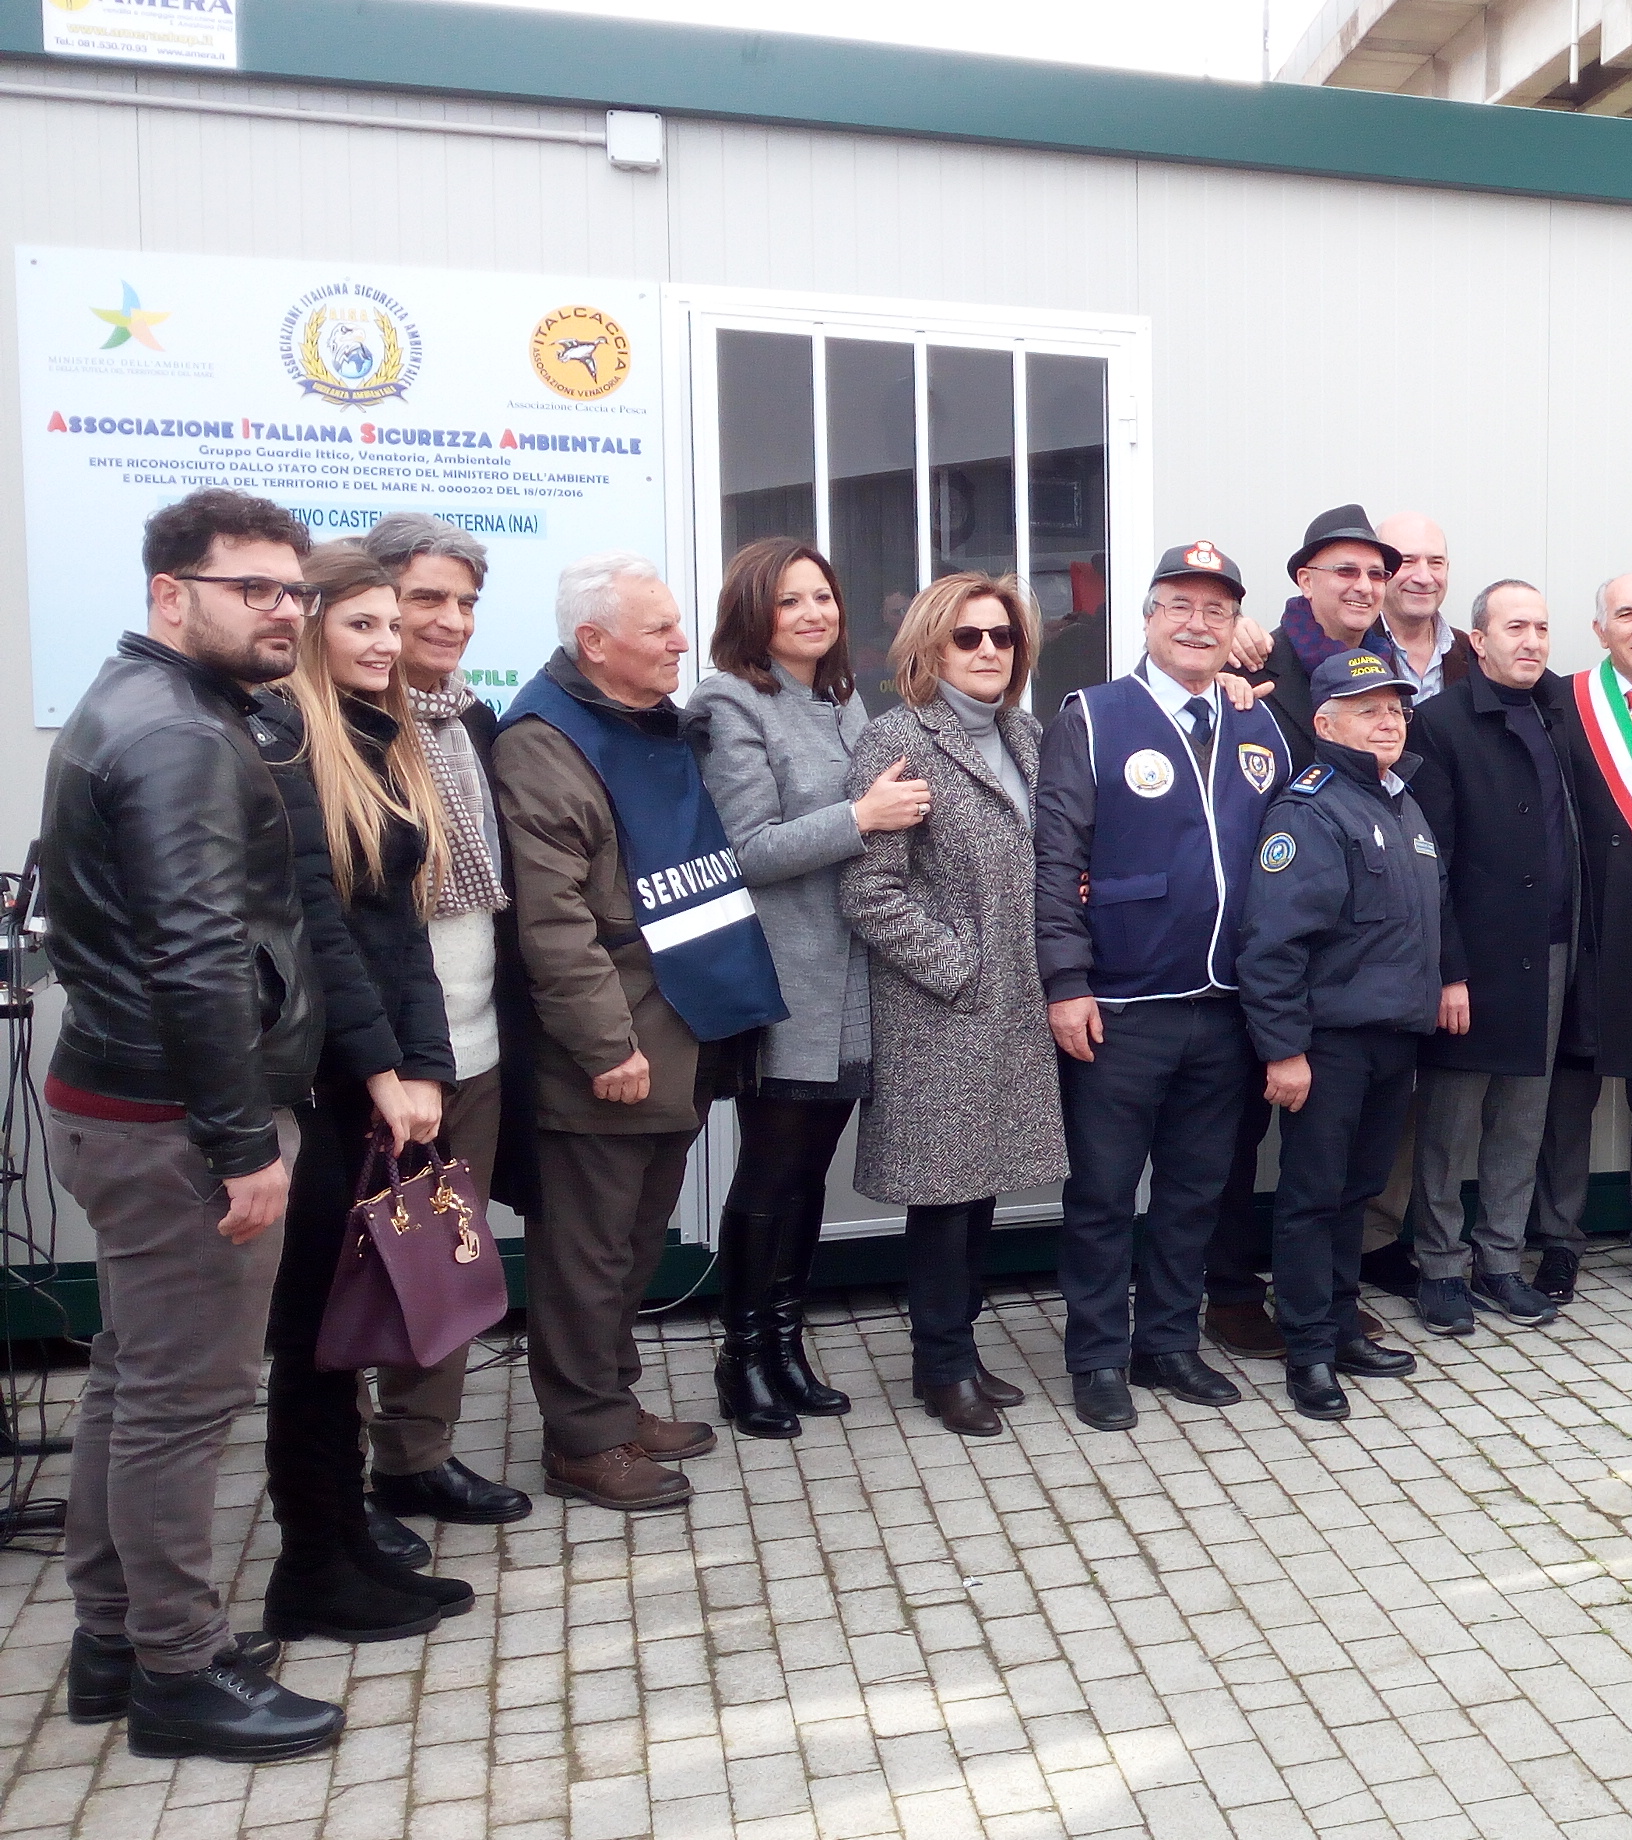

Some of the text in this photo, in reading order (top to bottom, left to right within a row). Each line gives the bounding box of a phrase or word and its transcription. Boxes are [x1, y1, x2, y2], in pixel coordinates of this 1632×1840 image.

[55, 36, 75, 46] Tel.:
[78, 39, 147, 52] 081.530.70.93
[279, 283, 422, 387] ASSOCIAZIONE ITALIANA SICUREZZA AMBIENTALE
[534, 308, 628, 372] ITALCACCIA
[48, 356, 214, 370] MINISTERO DELL'AMBIENTE
[533, 348, 621, 397] ASSOCIAZIONE VENATORIA
[507, 400, 572, 412] Associazione
[575, 403, 608, 413] Caccia
[620, 405, 647, 414] Pesca
[47, 410, 642, 455] ASSOCIAZIONE ITALIANA SICUREZZA AMBIENTALE
[199, 444, 512, 466] Gruppo Guardie Ittico, Venatoria, Ambientale
[89, 457, 610, 484] ENTE RICONOSCIUTO DALLO STATO CON DECRETO DEL MINISTERO DELL'AMBIENTE
[123, 474, 584, 498] E DELLA TUTELA DEL TERRITORIO E DEL MARE N. 0000202 DEL 18/07/2016
[328, 509, 382, 528] CASTE
[508, 514, 538, 534] (NA)
[636, 852, 728, 910] SERVIZIO
